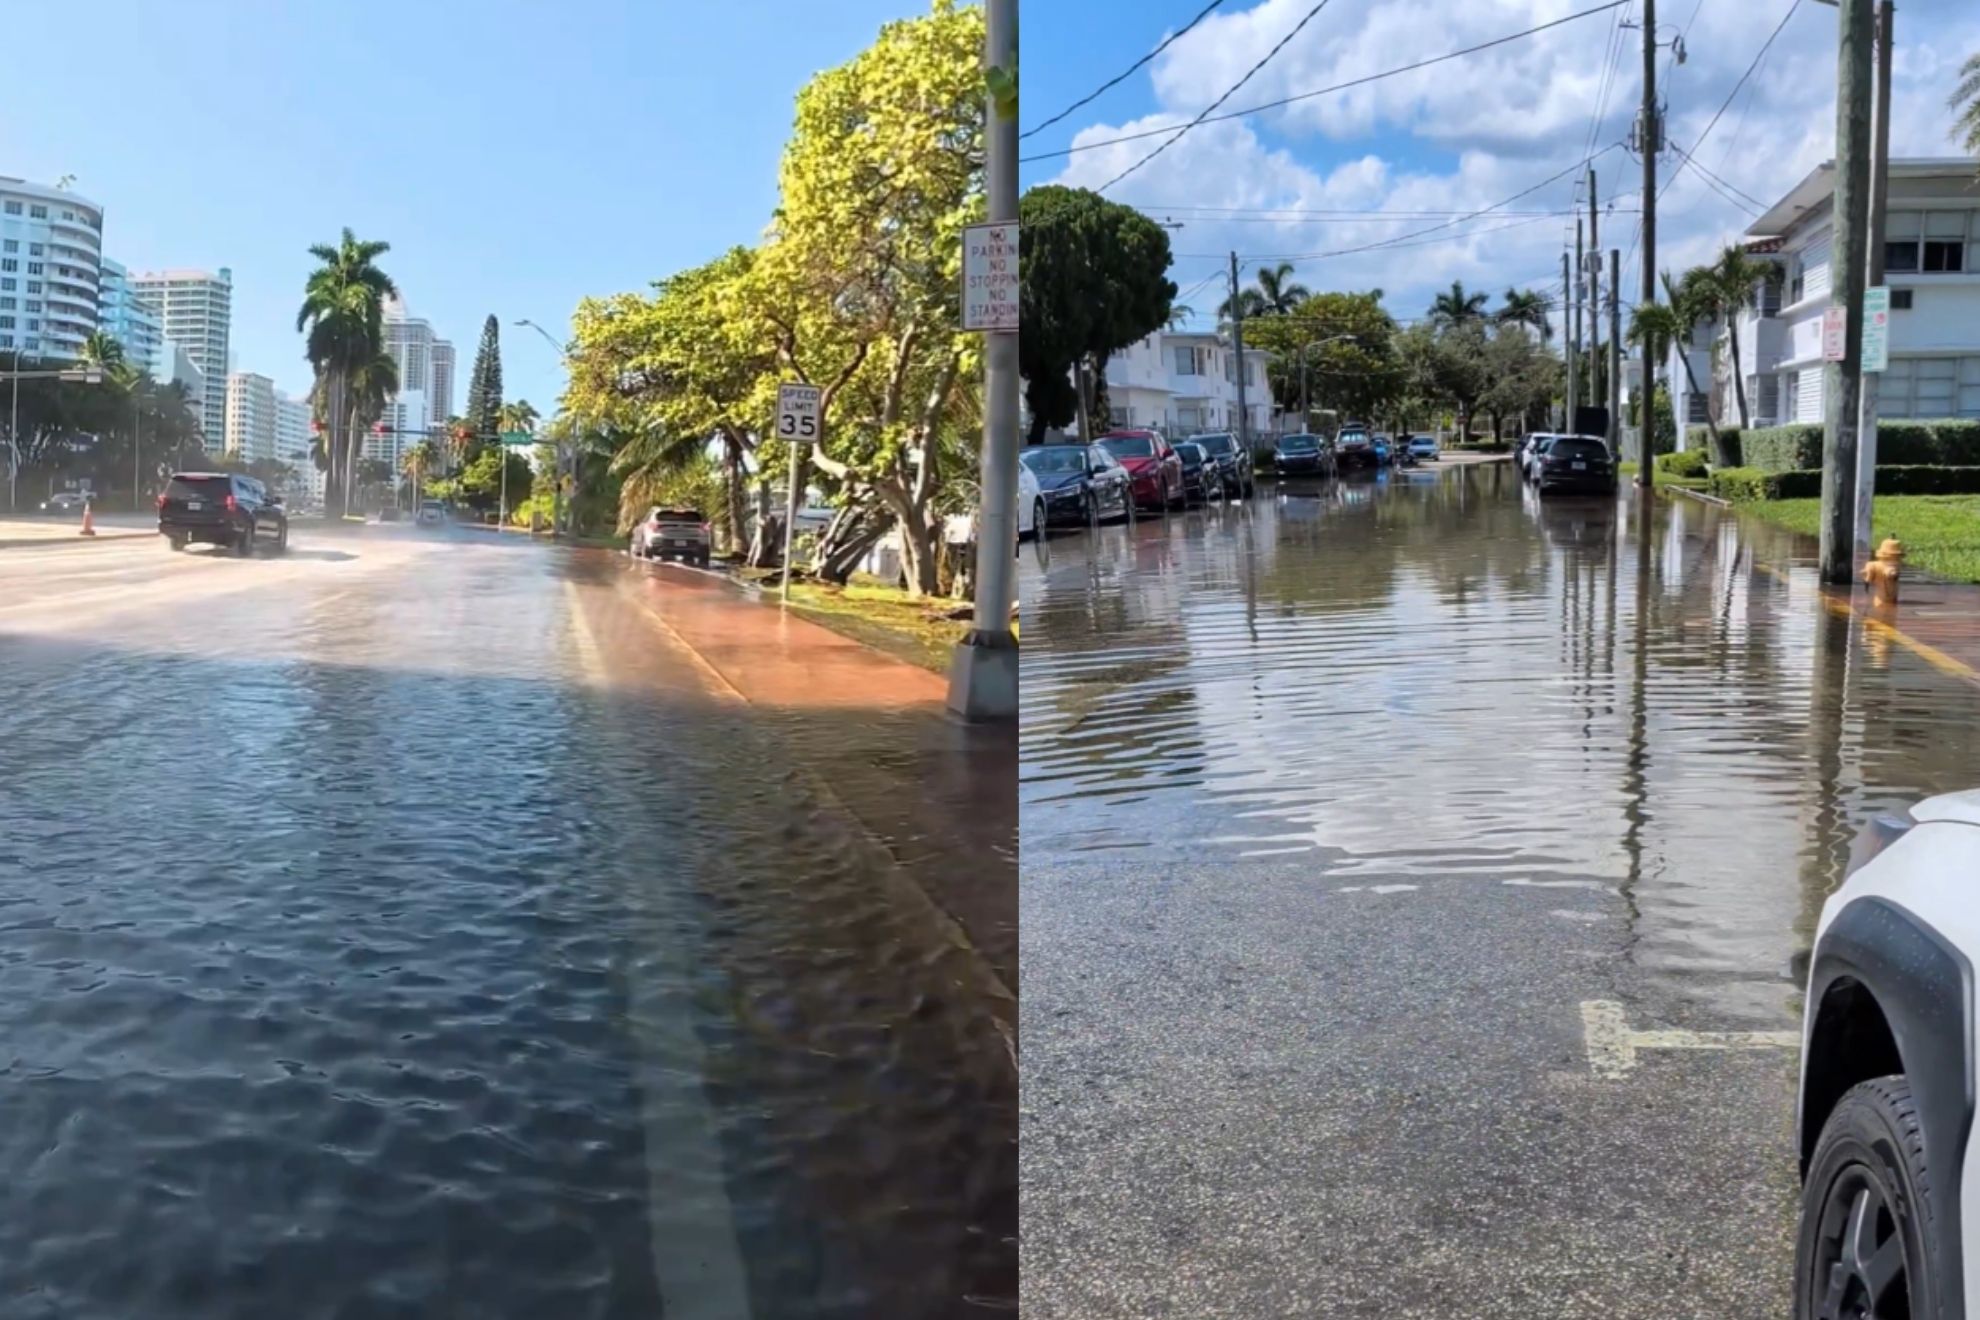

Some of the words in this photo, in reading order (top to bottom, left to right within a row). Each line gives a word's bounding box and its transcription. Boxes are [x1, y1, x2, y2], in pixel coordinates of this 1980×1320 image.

[990, 228, 1006, 242] NO
[971, 245, 1018, 257] PARKIN
[990, 260, 1006, 271] NO
[969, 274, 1018, 288] STOPPIN
[989, 288, 1006, 301] NO
[970, 304, 1018, 317] STANDIN
[782, 389, 817, 400] SPEED
[783, 402, 813, 412] LIMIT
[781, 414, 815, 436] 35
